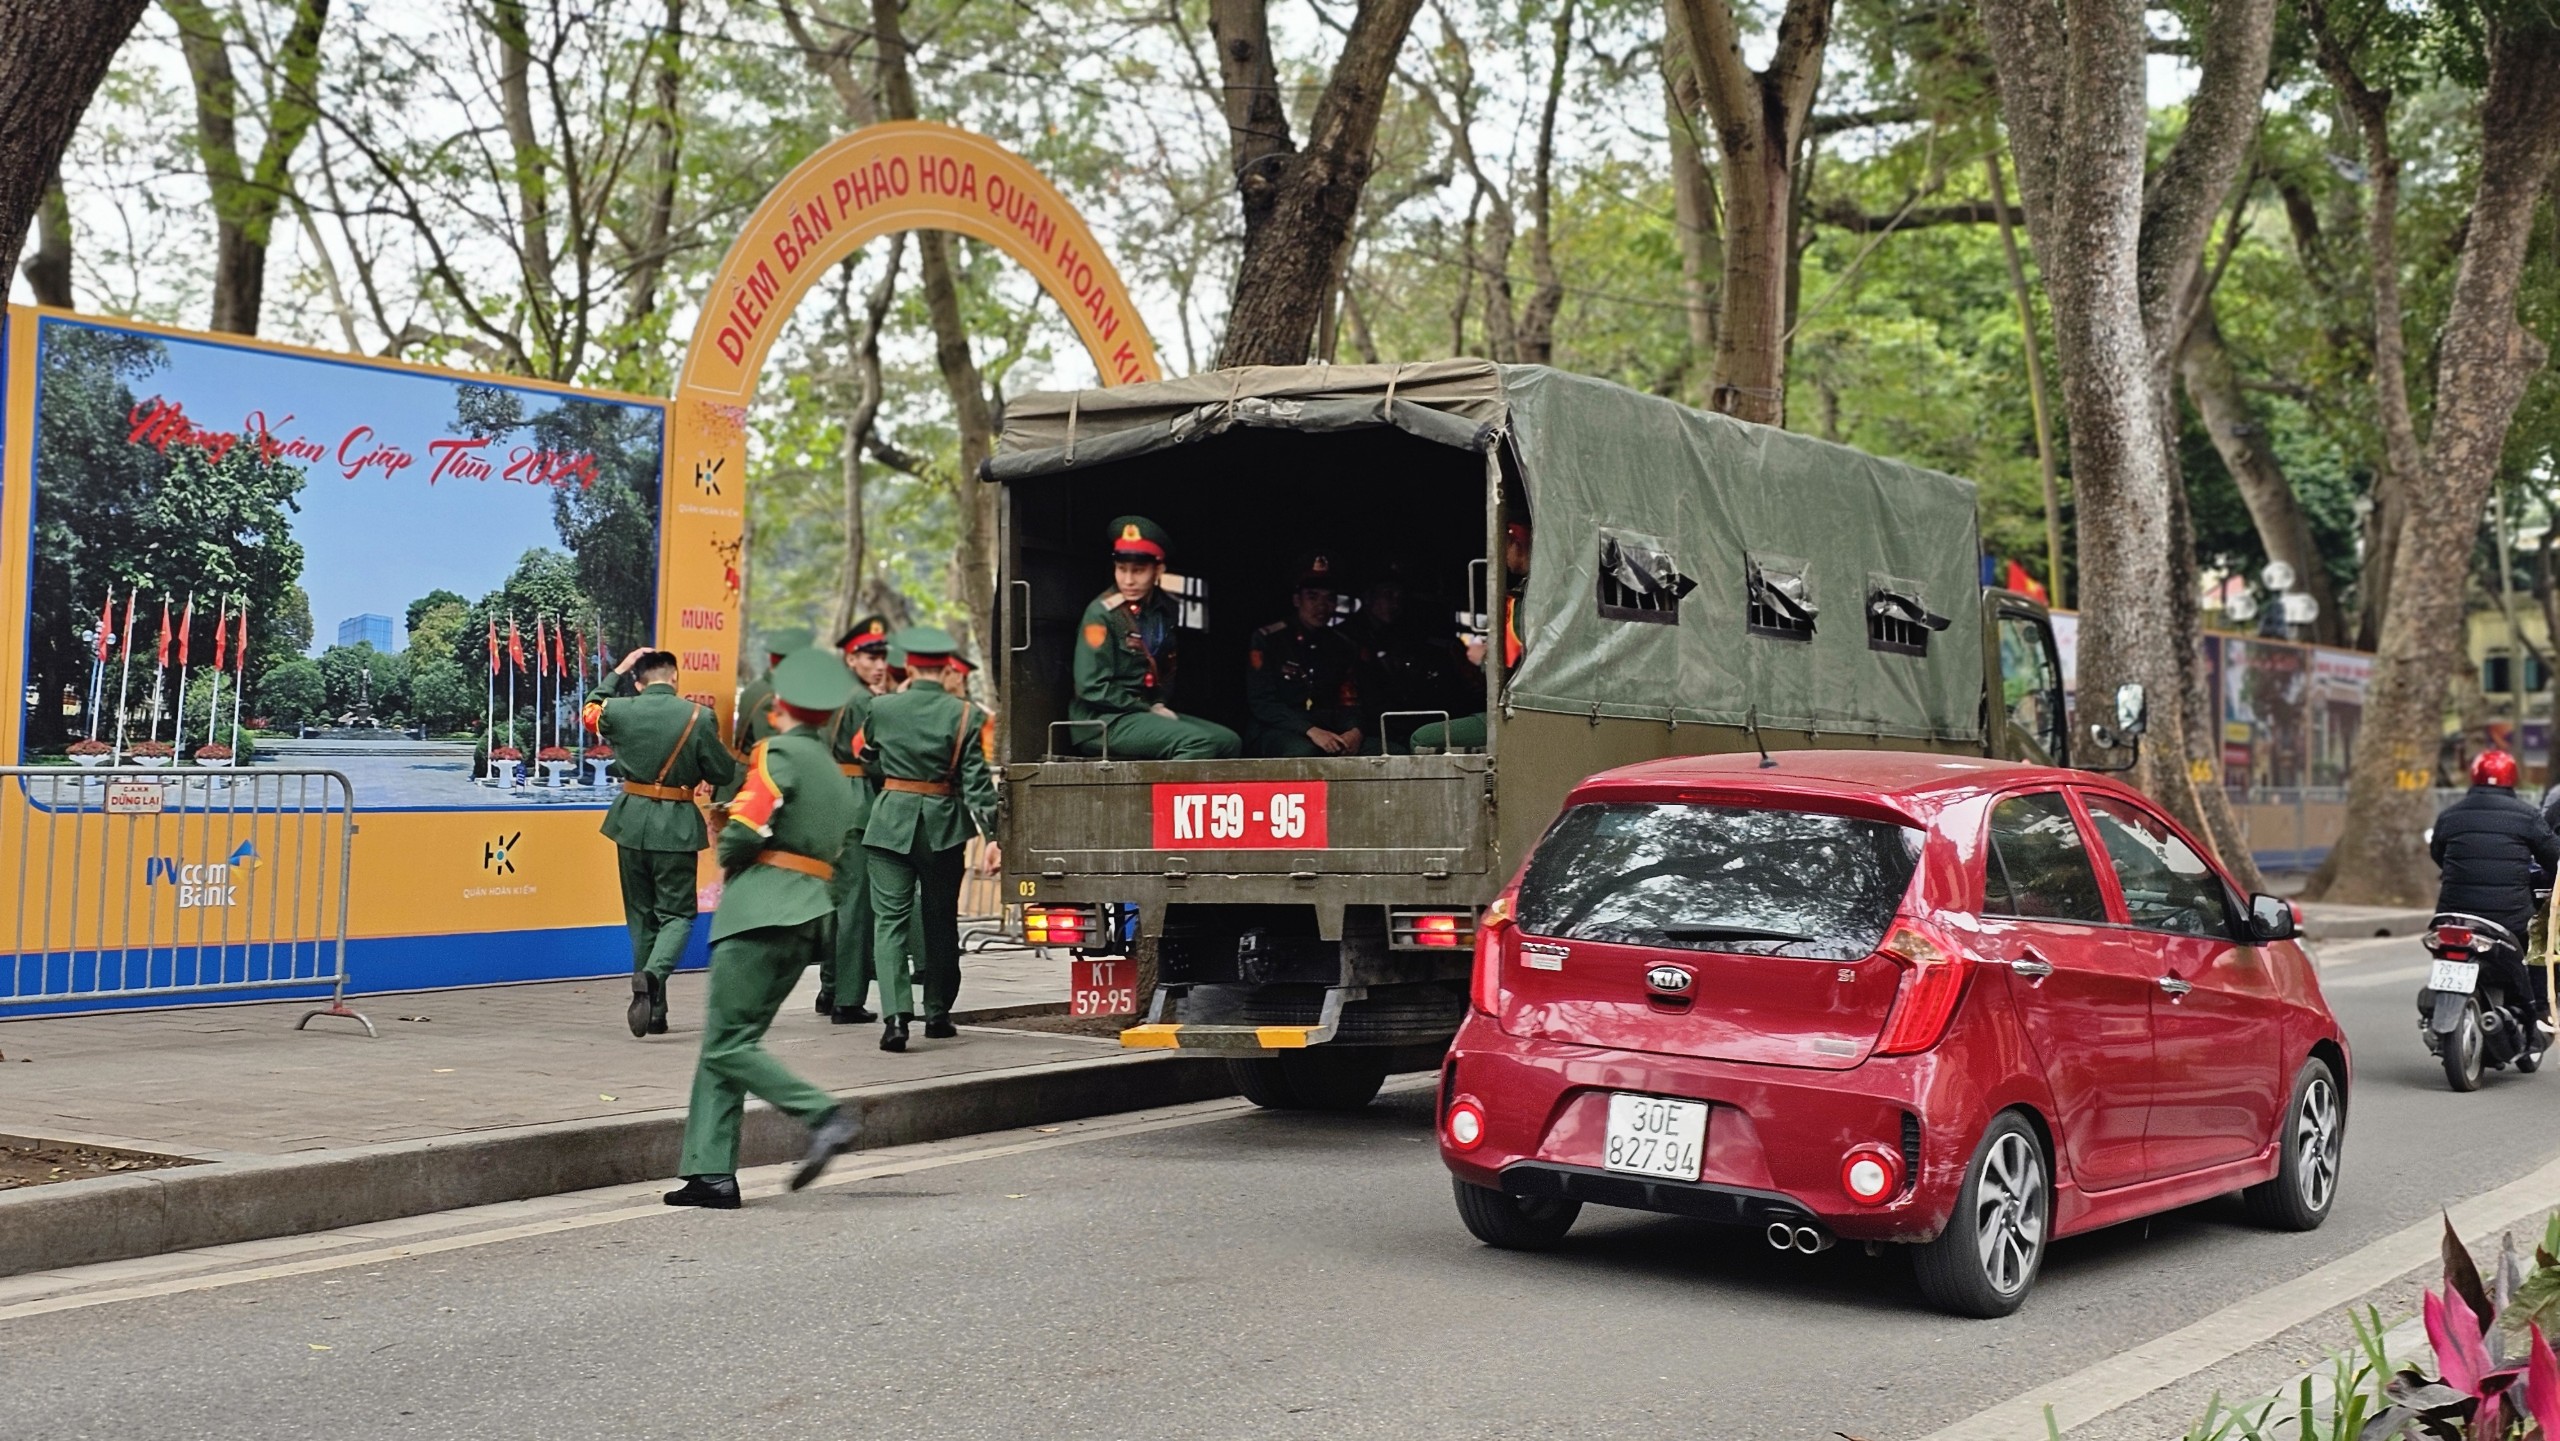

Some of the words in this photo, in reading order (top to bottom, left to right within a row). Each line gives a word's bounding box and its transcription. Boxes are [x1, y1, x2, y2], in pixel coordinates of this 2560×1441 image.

[919, 155, 977, 203] HOA
[502, 445, 599, 490] 2024
[1173, 794, 1208, 840] KT
[1210, 793, 1245, 839] 59
[1270, 793, 1306, 839] 95
[179, 885, 237, 908] Bank
[1019, 880, 1036, 897] 03
[1092, 962, 1116, 986] KT
[1652, 971, 1684, 988] KIA
[1076, 988, 1132, 1015] 59-95
[1632, 1101, 1682, 1136] 30E
[1609, 1134, 1694, 1175] 827.94
